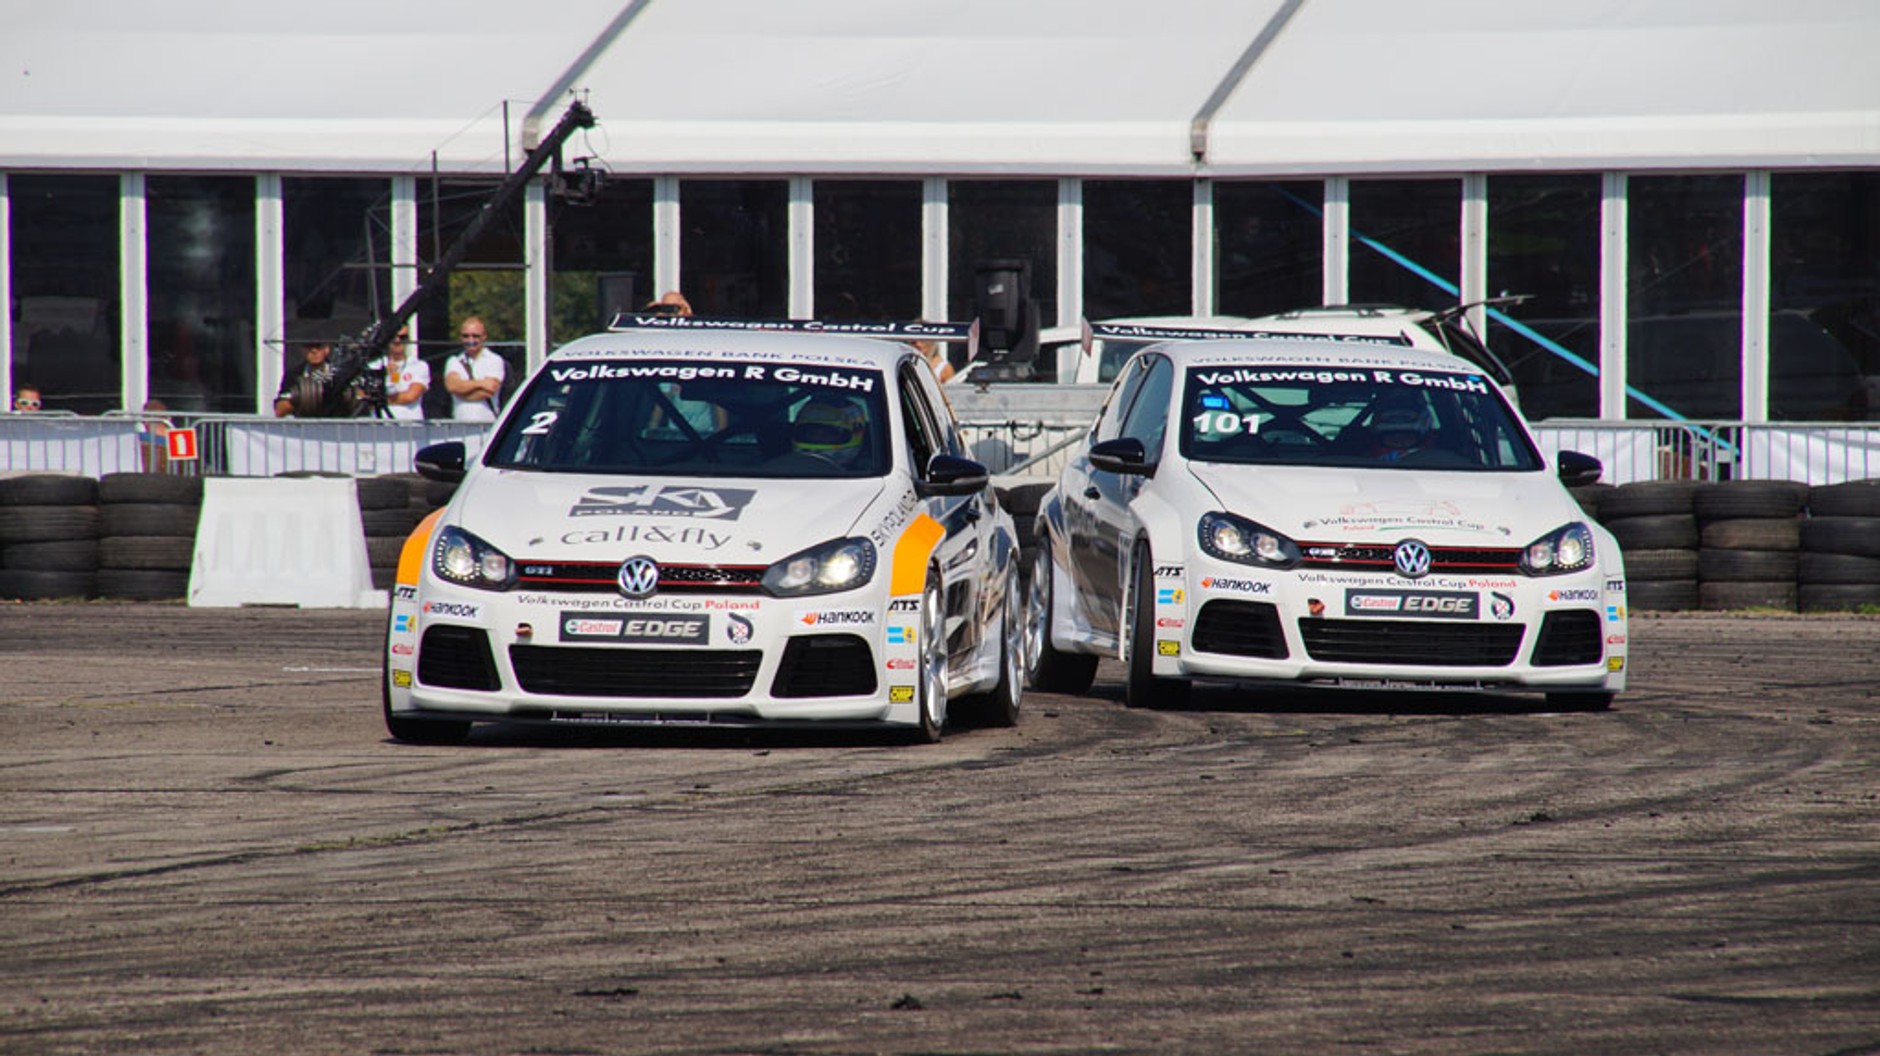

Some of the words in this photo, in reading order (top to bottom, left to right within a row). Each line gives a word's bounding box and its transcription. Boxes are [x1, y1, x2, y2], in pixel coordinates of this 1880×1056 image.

[635, 317, 794, 330] Volkswagen
[803, 321, 896, 332] Castrol
[904, 324, 955, 334] Cup
[1101, 326, 1246, 339] Volkswagen
[551, 365, 736, 382] Volkswagen
[744, 366, 766, 380] R
[773, 368, 874, 392] GmbH
[1197, 369, 1367, 385] Volkswagen
[1373, 371, 1394, 384] R
[1400, 373, 1488, 395] GmbH
[521, 411, 558, 435] 2
[1193, 411, 1260, 435] 101
[561, 526, 732, 551] call&fly
[1298, 573, 1384, 586] Volkswagen
[1439, 577, 1467, 589] Cup
[1468, 578, 1517, 588] Poland
[517, 594, 610, 609] Volkswagen
[613, 599, 668, 609] Castrol
[672, 599, 702, 610] Cup
[705, 599, 760, 610] Poland
[888, 600, 919, 611] ATS
[1362, 596, 1399, 608] Castrol
[1403, 596, 1473, 613] EDGE
[578, 621, 618, 634] Castrol
[624, 620, 705, 637] EDGE
